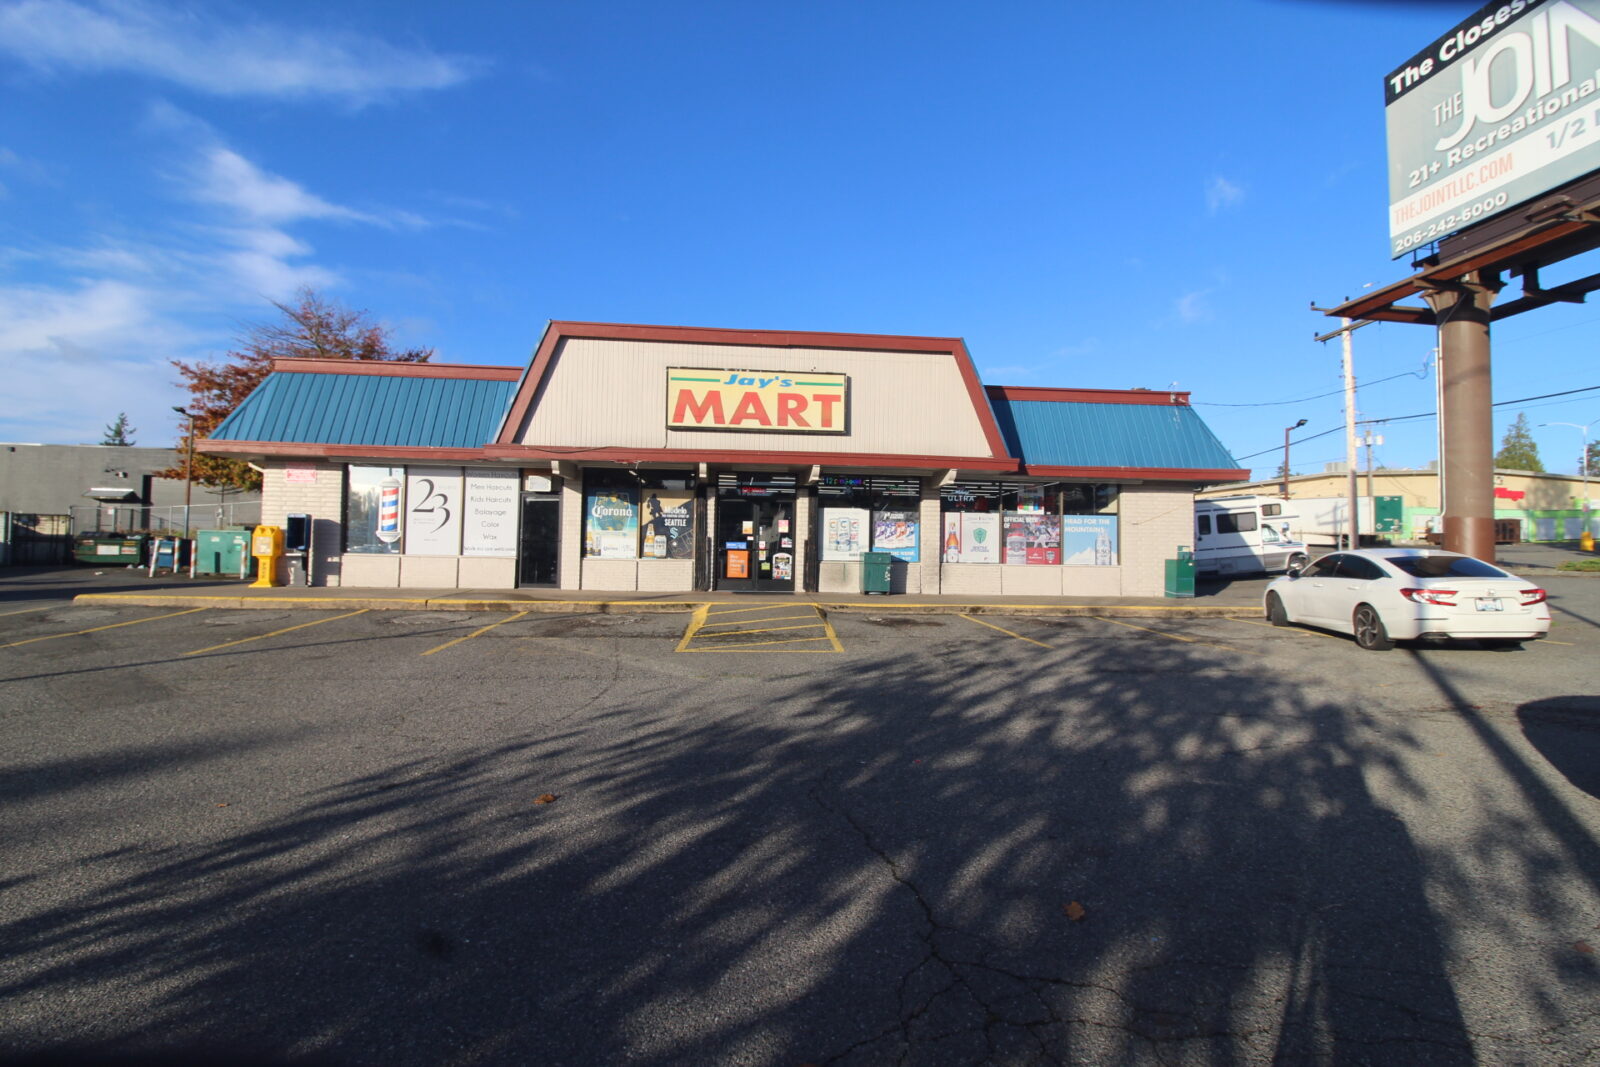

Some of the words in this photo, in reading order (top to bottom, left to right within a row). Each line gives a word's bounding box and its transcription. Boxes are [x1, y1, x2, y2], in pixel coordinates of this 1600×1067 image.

[1390, 57, 1434, 95] The
[1439, 0, 1535, 63] Closes
[1432, 91, 1463, 127] THE
[1409, 160, 1441, 188] 21+
[1447, 68, 1600, 168] Recreational
[1546, 117, 1586, 149] 1/2
[1394, 152, 1513, 225] THEJOINTLLC.COM
[1394, 191, 1508, 252] 206-242-6000
[723, 374, 793, 388] Jay's
[672, 389, 842, 428] MART
[412, 478, 450, 534] 23
[481, 520, 500, 528] Color
[592, 505, 633, 519] Corona
[664, 518, 688, 526] SEATTLE
[482, 532, 497, 540] Wax
